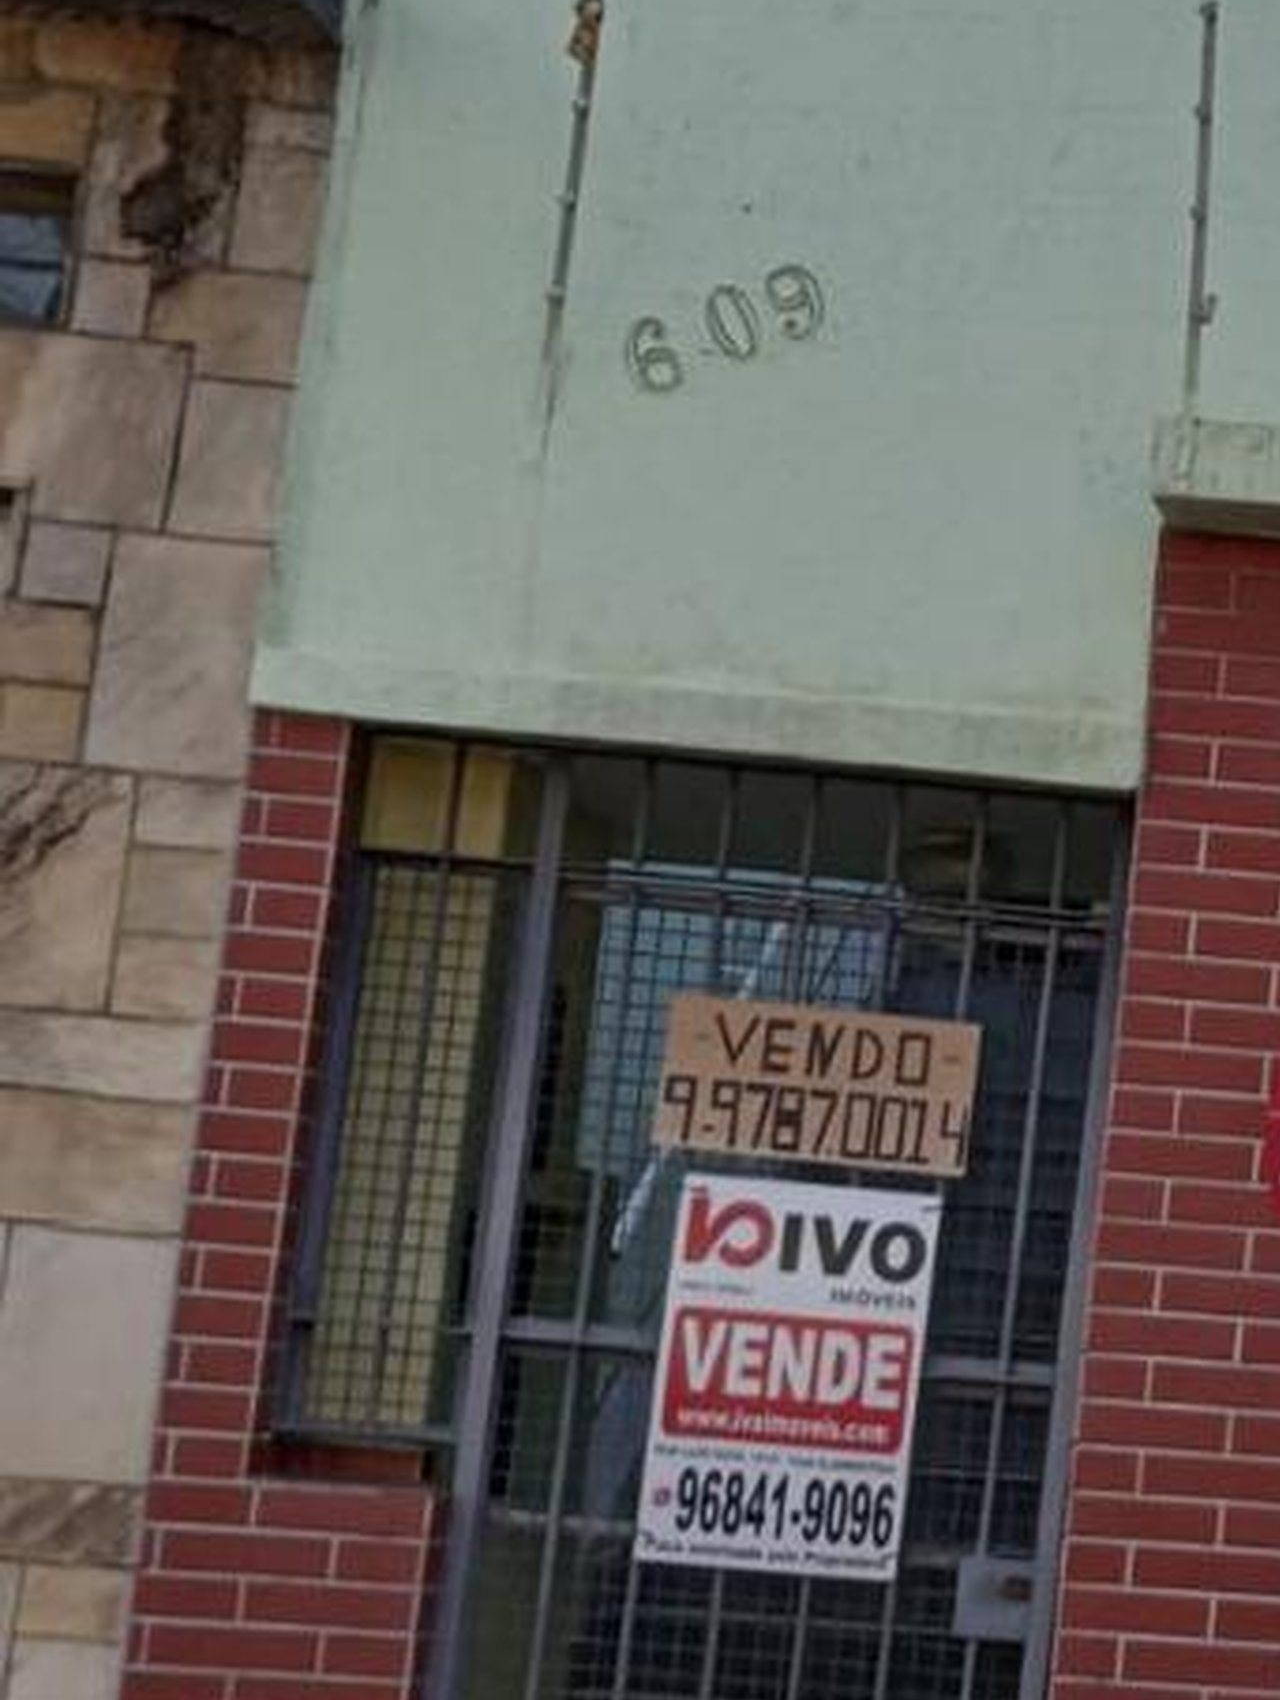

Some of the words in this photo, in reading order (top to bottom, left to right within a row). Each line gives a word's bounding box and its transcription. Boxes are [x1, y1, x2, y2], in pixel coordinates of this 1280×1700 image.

[714, 1011, 933, 1088] VENDO
[777, 1209, 928, 1284] IVO
[681, 1314, 906, 1412] VENDE
[674, 1465, 896, 1550] 96841-9096
